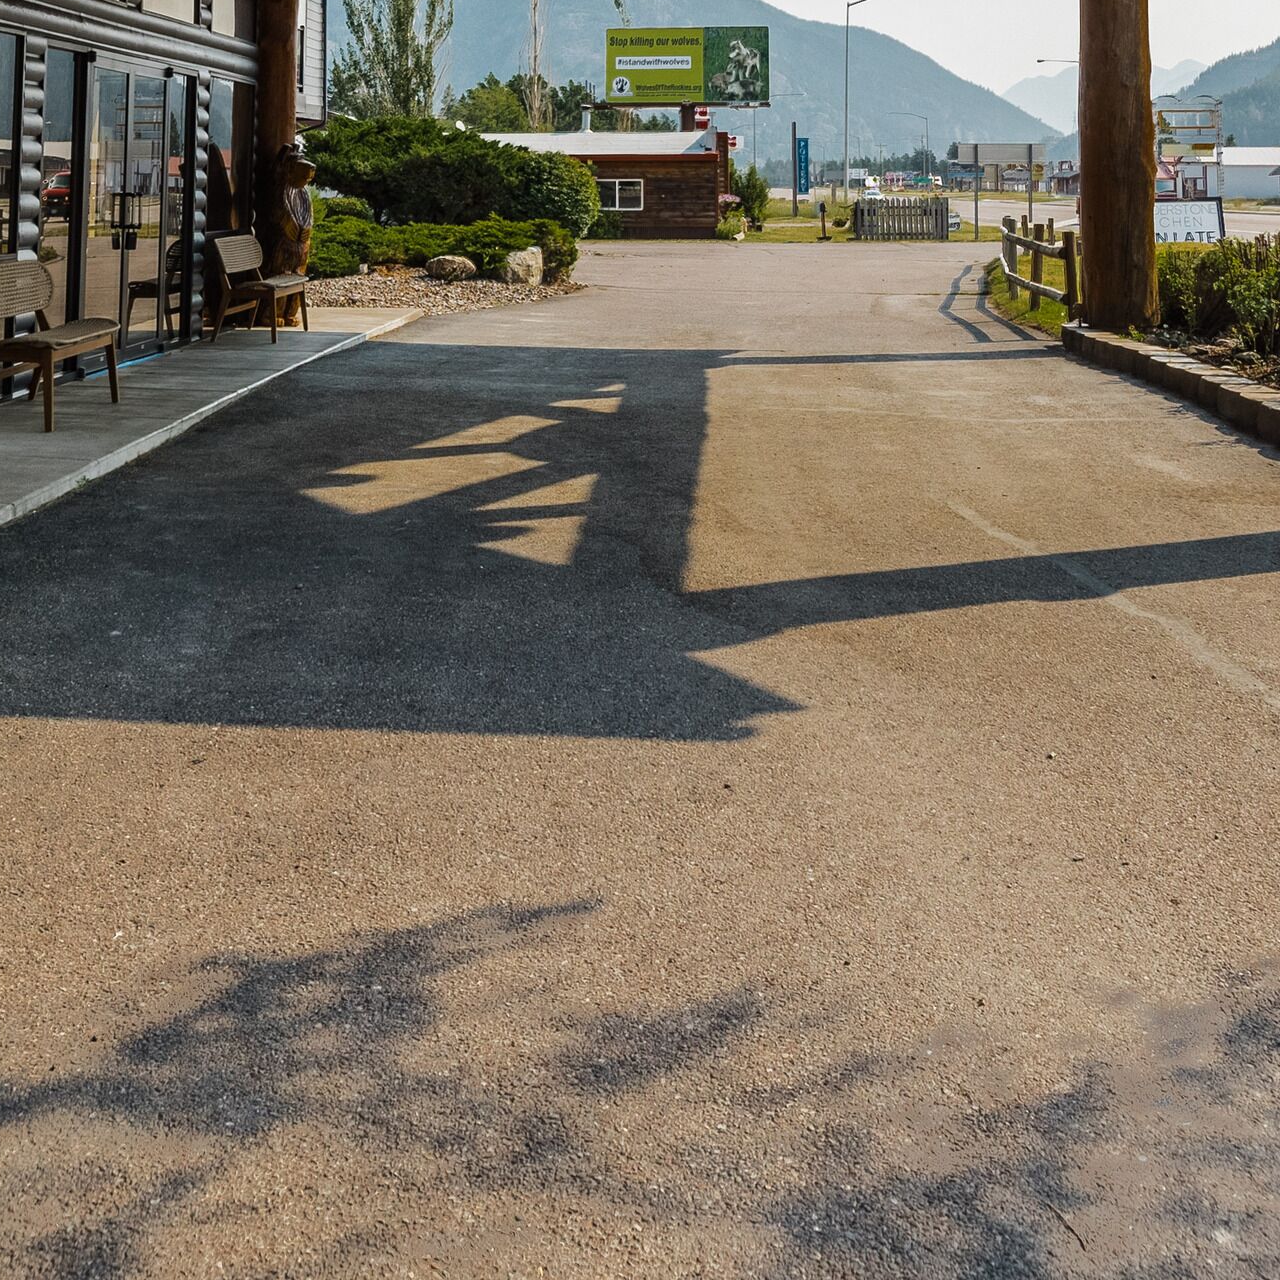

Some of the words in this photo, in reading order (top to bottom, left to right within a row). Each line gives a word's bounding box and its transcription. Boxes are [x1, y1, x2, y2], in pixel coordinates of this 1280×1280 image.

[610, 36, 628, 48] Stop
[629, 35, 654, 48] killing
[656, 37, 669, 46] our
[671, 36, 702, 46] wolves.
[618, 58, 690, 66] #istandwithwolves
[800, 141, 808, 192] POTTERY
